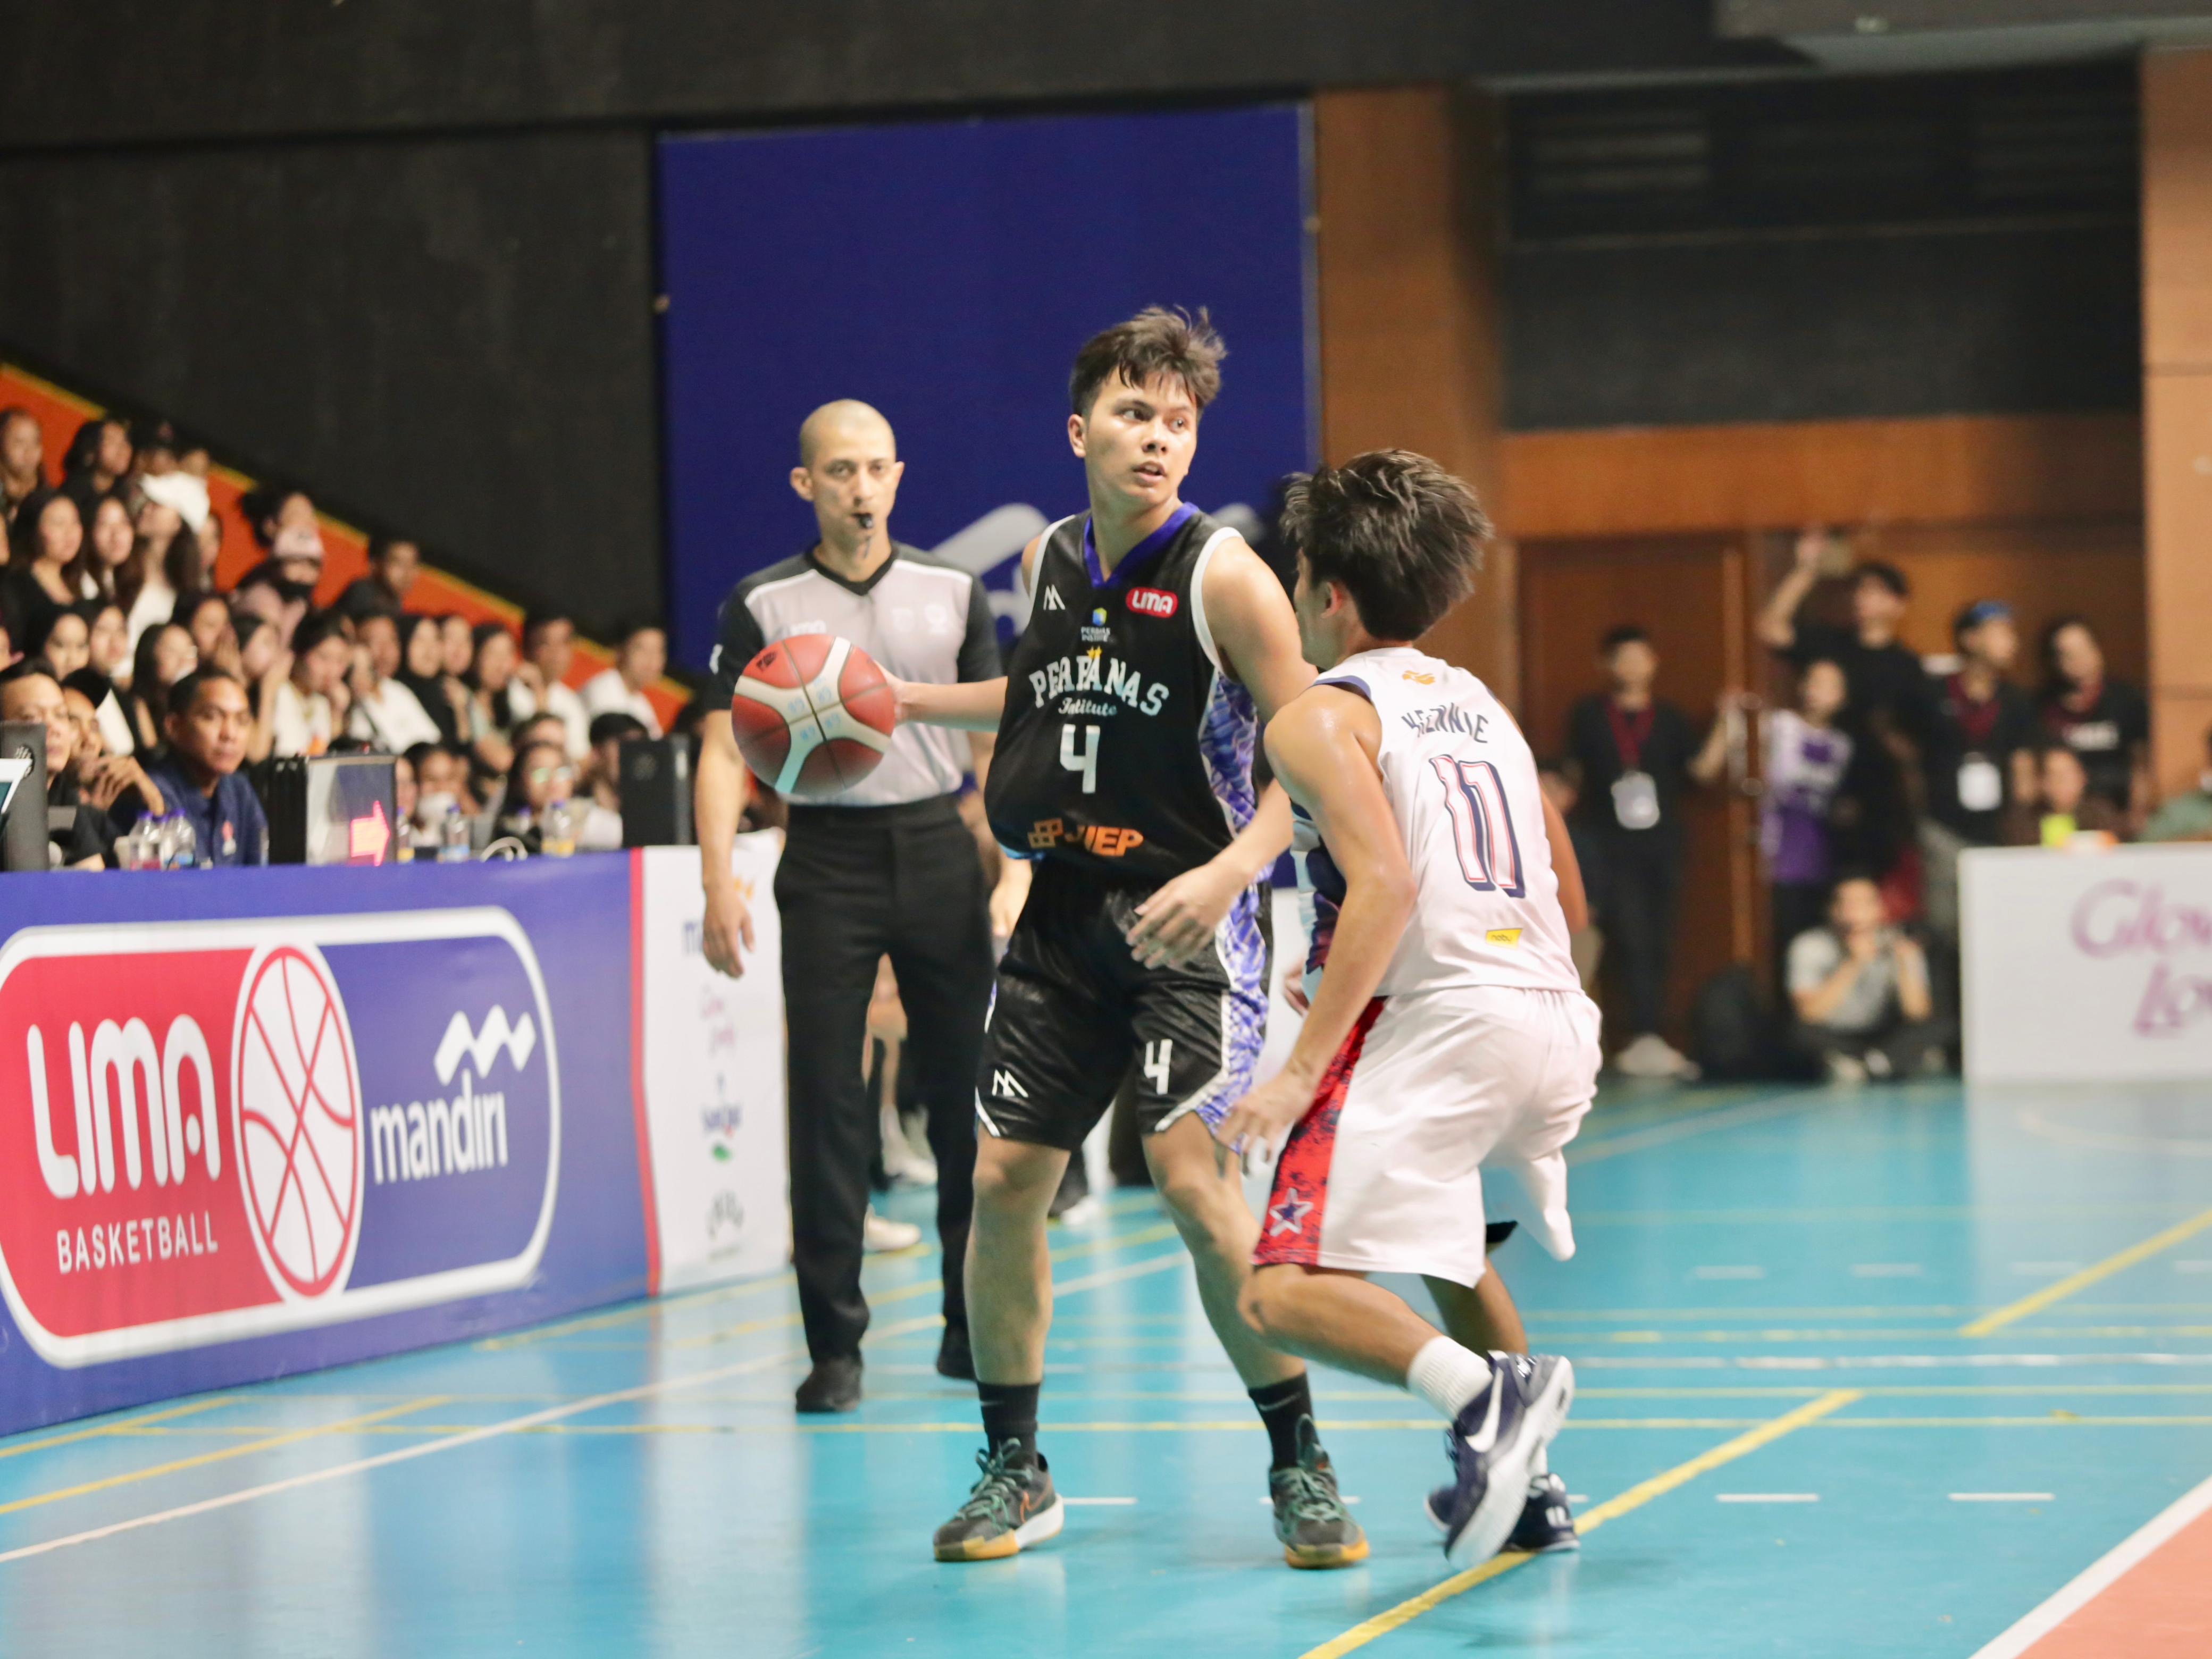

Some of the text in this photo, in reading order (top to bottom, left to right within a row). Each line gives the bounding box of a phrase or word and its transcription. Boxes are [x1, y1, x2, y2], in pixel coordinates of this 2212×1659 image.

[1132, 590, 1173, 614] LIMA
[1401, 702, 1488, 743] KENNIE
[1060, 724, 1100, 793] 4
[1144, 1039, 1172, 1094] 4
[27, 1013, 221, 1199] LIMA
[370, 1068, 508, 1184] mandiri
[56, 1210, 219, 1274] BASKETBALL
